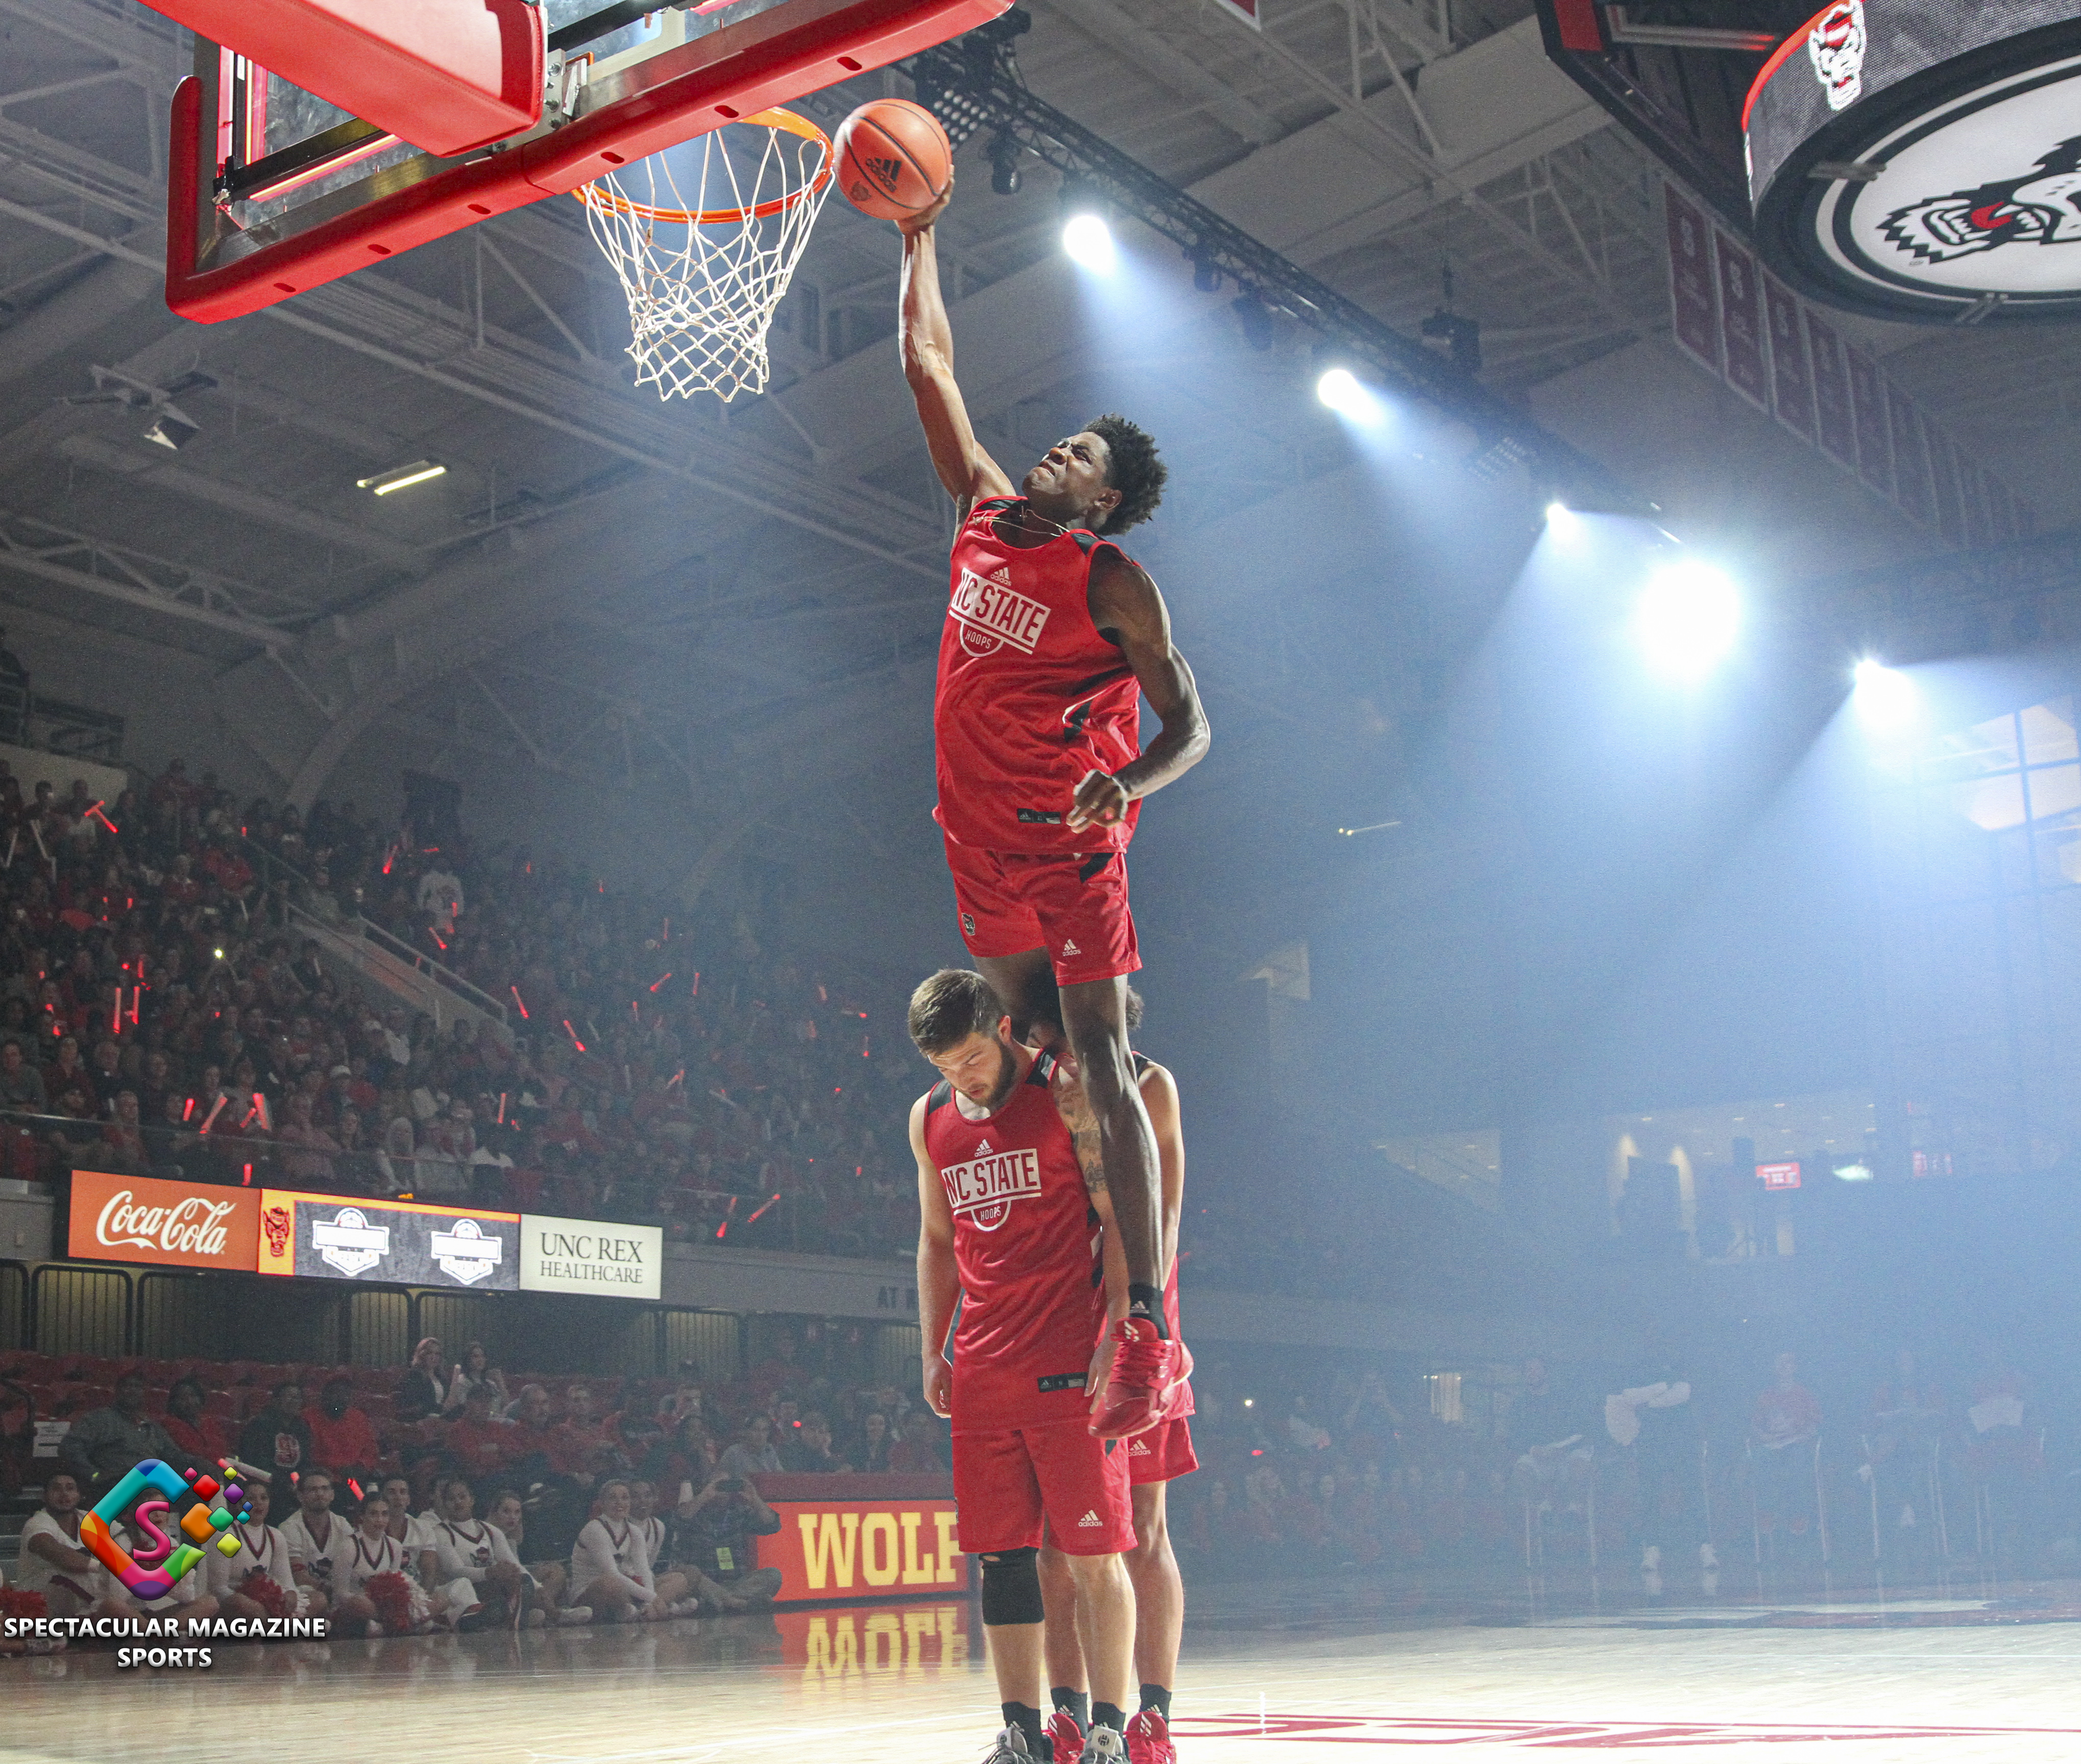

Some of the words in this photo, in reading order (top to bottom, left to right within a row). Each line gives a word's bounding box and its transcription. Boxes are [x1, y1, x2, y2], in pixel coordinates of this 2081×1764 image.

[865, 158, 897, 192] adidas
[990, 573, 1012, 586] adidas
[953, 572, 978, 611] NC
[975, 584, 1046, 643] STATE
[965, 630, 991, 649] HOOPS
[975, 1148, 993, 1157] adidas
[944, 1167, 970, 1205] NC
[974, 1153, 1037, 1196] STATE
[96, 1190, 236, 1255] Coca-Cola
[980, 1206, 1001, 1221] HOOPS
[541, 1232, 591, 1259] UNC
[598, 1238, 643, 1263] REX
[541, 1261, 643, 1283] HEALTHCARE
